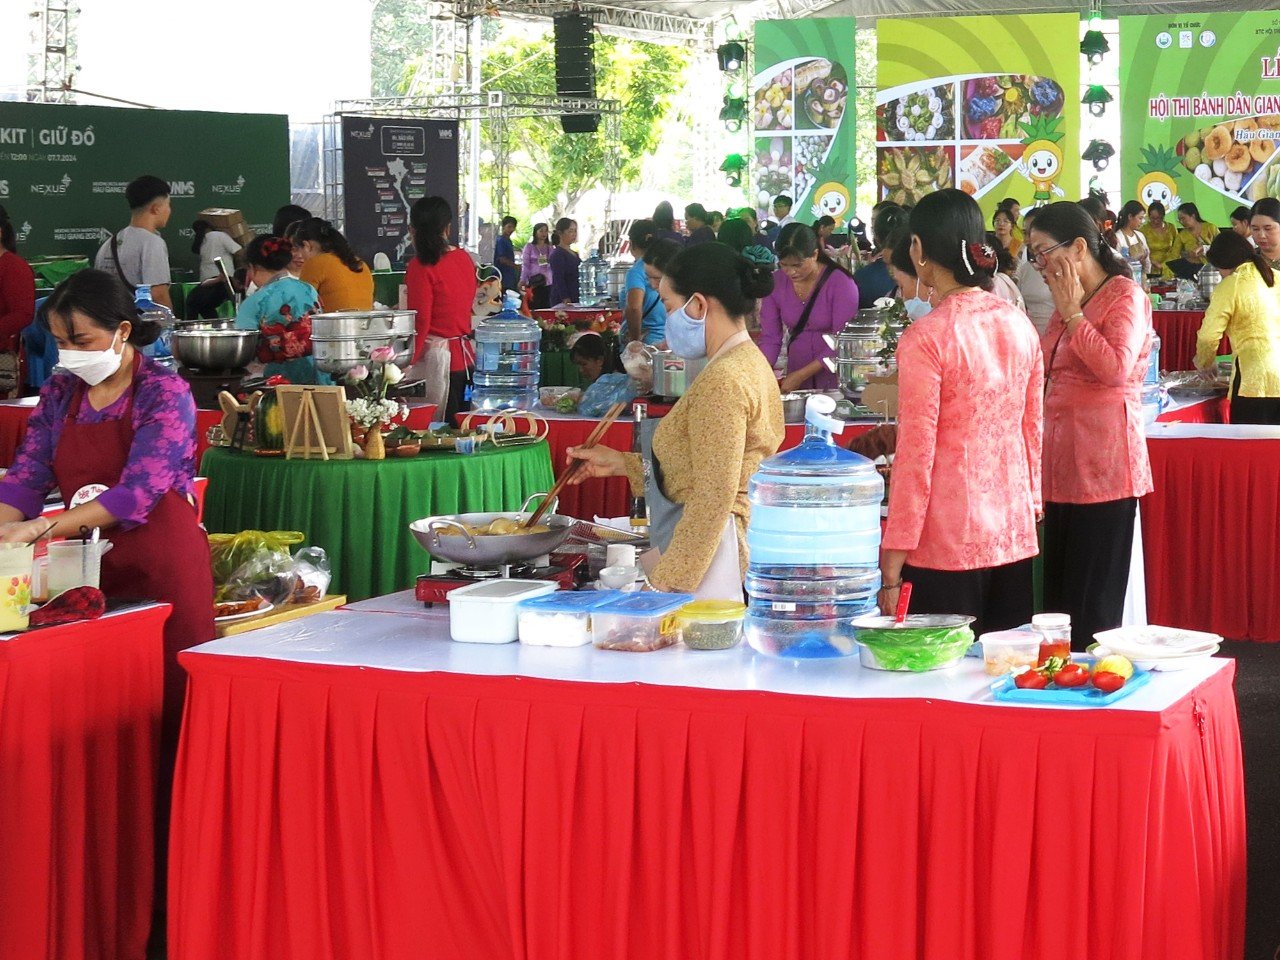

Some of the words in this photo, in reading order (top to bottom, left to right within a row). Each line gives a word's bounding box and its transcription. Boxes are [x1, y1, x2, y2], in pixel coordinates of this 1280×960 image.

[1150, 93, 1169, 121] HỘI
[1172, 97, 1190, 116] THI
[1193, 92, 1224, 116] BÁNH
[1227, 91, 1251, 115] DÂN
[0, 128, 26, 144] KIT
[39, 126, 68, 145] GIỮ
[71, 125, 95, 146] ĐỒ
[1235, 129, 1255, 141] Hậu
[31, 184, 66, 194] NEXUS
[212, 184, 240, 194] NEXUS
[179, 229, 195, 239] NEX
